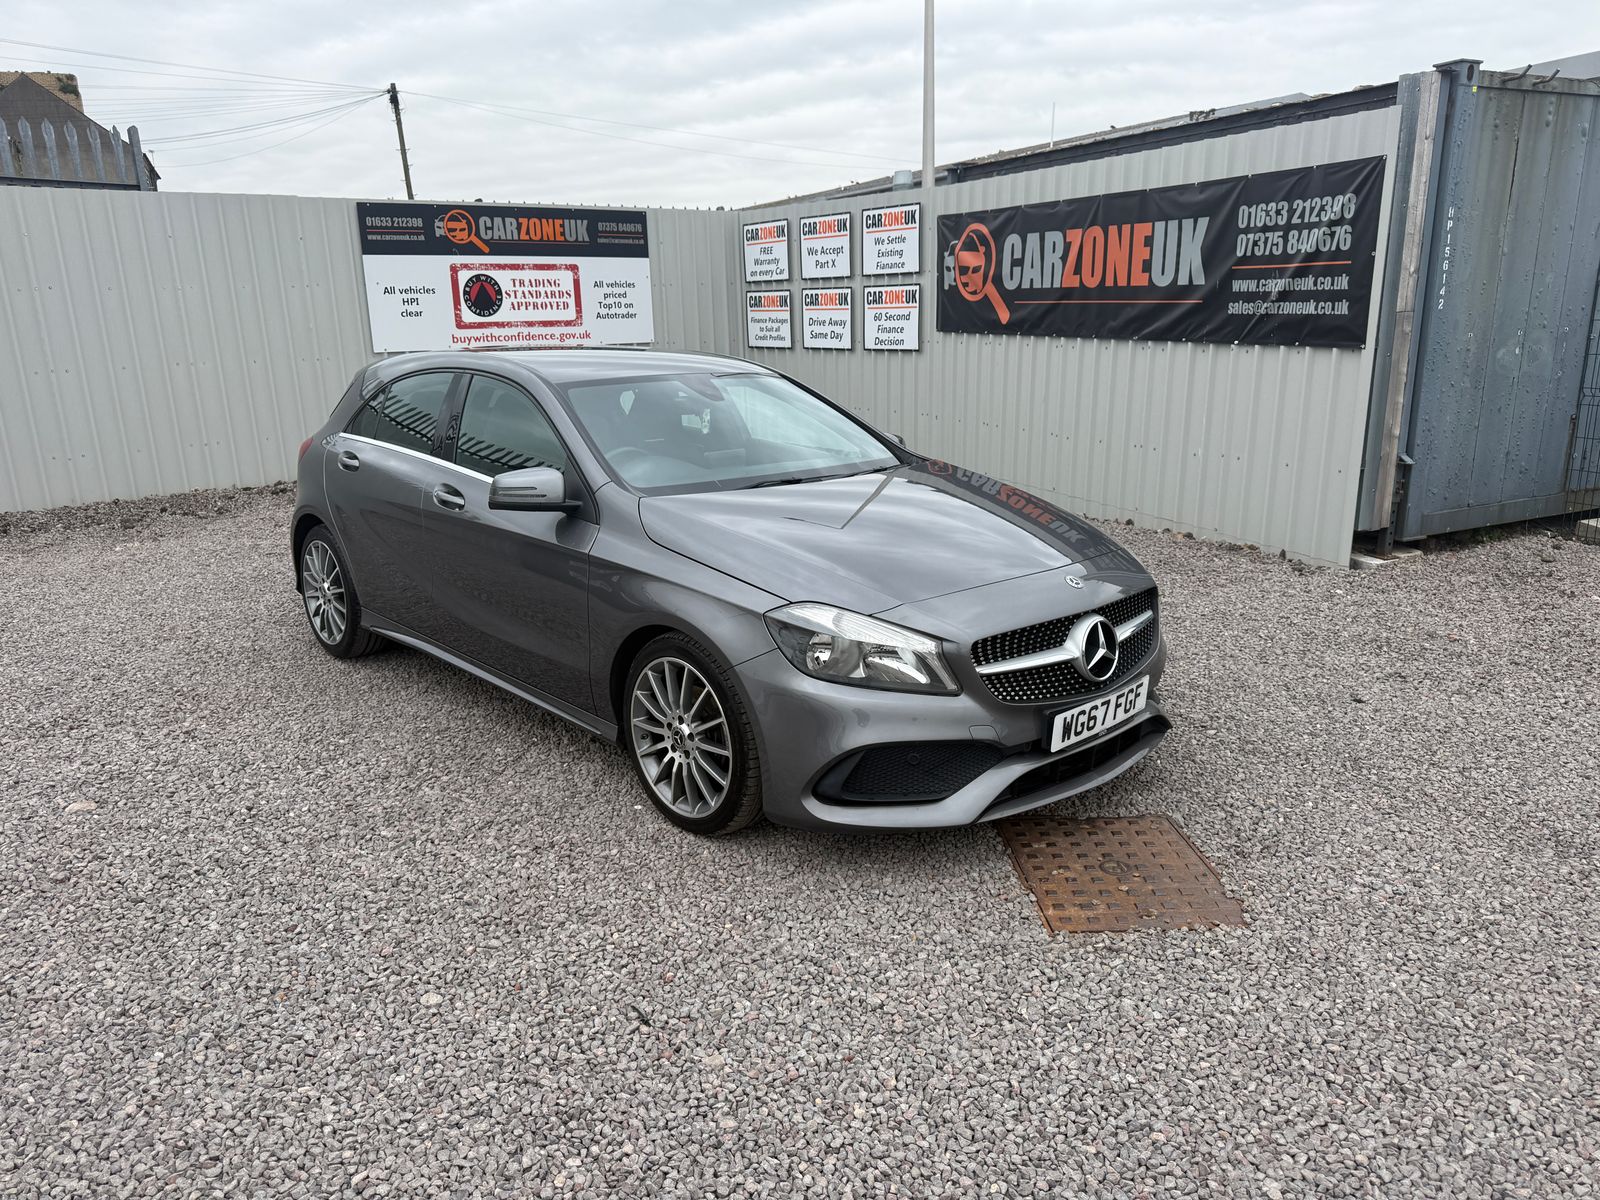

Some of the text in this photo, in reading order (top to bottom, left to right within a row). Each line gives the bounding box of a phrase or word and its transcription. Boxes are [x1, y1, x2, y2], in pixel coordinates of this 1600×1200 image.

[1238, 193, 1357, 228] 01633 212398
[366, 216, 423, 227] 01633 212398
[865, 209, 917, 229] CARZONEUK
[479, 216, 590, 242] CARZONEUK
[598, 222, 618, 232] 07375
[802, 217, 848, 236] CARZONEUK
[745, 224, 786, 242] CARZONEUK
[874, 234, 907, 246] We Settle
[1236, 224, 1352, 257] 07375 840676
[760, 246, 774, 255] FREE
[807, 246, 844, 257] We Accept
[877, 248, 904, 259] Existing
[1002, 217, 1210, 290] CARZONEUK
[753, 257, 780, 267] Warranty
[815, 258, 836, 269] Part X
[876, 261, 906, 270] Fianance
[758, 269, 774, 278] every
[775, 266, 785, 275] Car
[510, 278, 560, 288] TRADING
[605, 280, 636, 288] vehicles
[1232, 273, 1349, 292] www.carzoneuk.co.uk
[383, 286, 436, 295] All vehicles
[504, 290, 572, 299] STANDARDS
[603, 291, 627, 299] priced
[402, 298, 420, 306] HPI
[749, 295, 789, 308] CARZONEUK
[804, 292, 849, 307] CARZONEUK
[866, 289, 918, 305] CARZONEUK
[509, 301, 569, 311] APPROVED
[598, 301, 622, 310] Top10
[1228, 299, 1349, 315] sales@carzoneuk.co.uk
[401, 309, 423, 317] clear
[873, 311, 911, 322] 60 Second
[768, 317, 789, 325] Packages
[808, 317, 847, 329] Drive Away
[765, 325, 774, 333] Suit
[877, 324, 905, 334] Finance
[451, 330, 591, 346] buywithconfidence.gov.uk
[810, 330, 844, 342] Same Day
[874, 336, 905, 346] Decision
[1061, 681, 1144, 743] WG67 FGF
